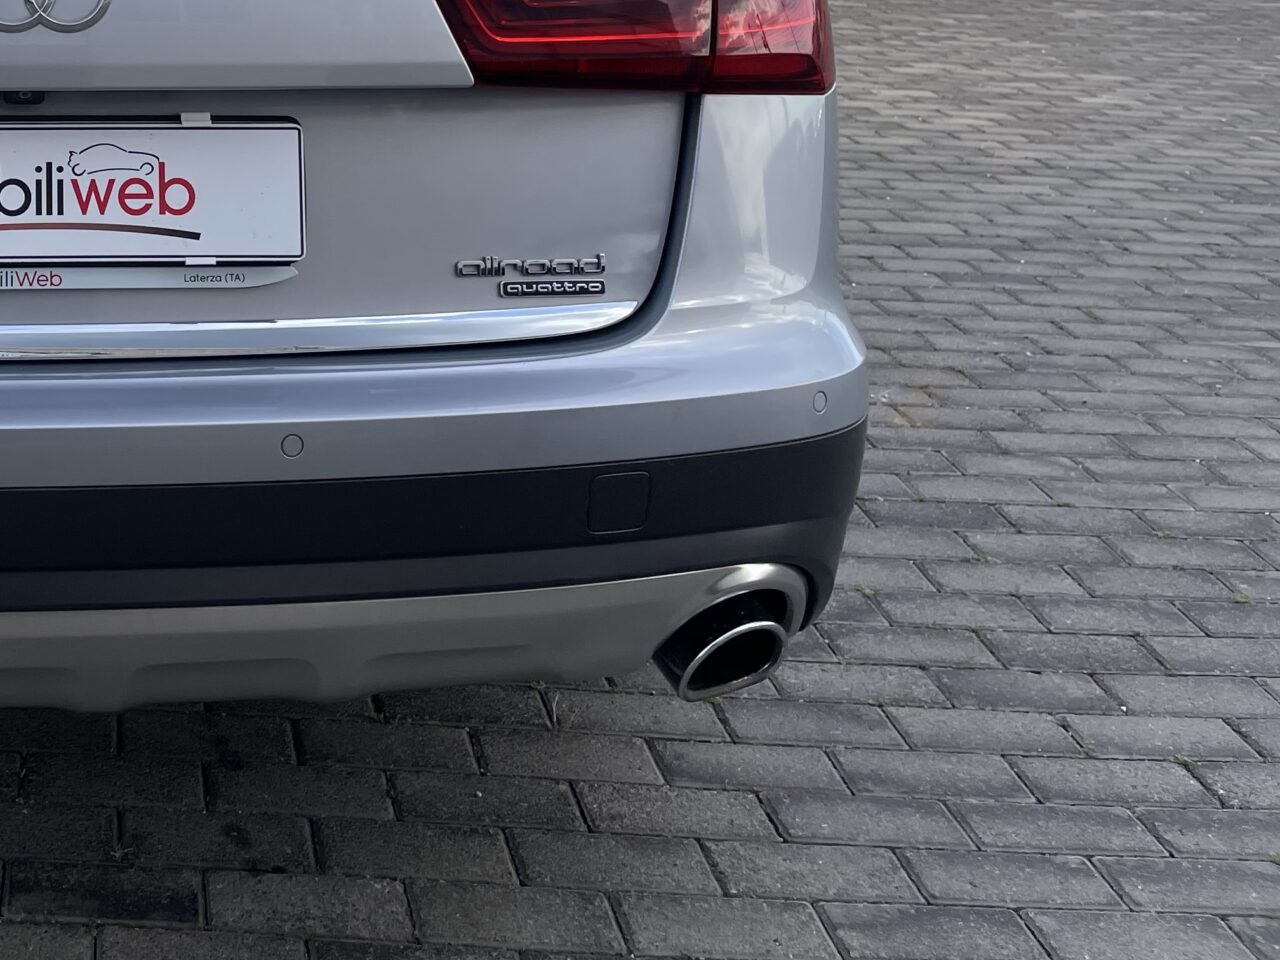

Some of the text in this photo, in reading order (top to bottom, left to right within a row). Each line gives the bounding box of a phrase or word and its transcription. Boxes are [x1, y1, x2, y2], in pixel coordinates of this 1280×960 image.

[455, 253, 606, 278] allroad
[183, 272, 246, 283] Laterza (TA)
[506, 281, 603, 296] quattro
